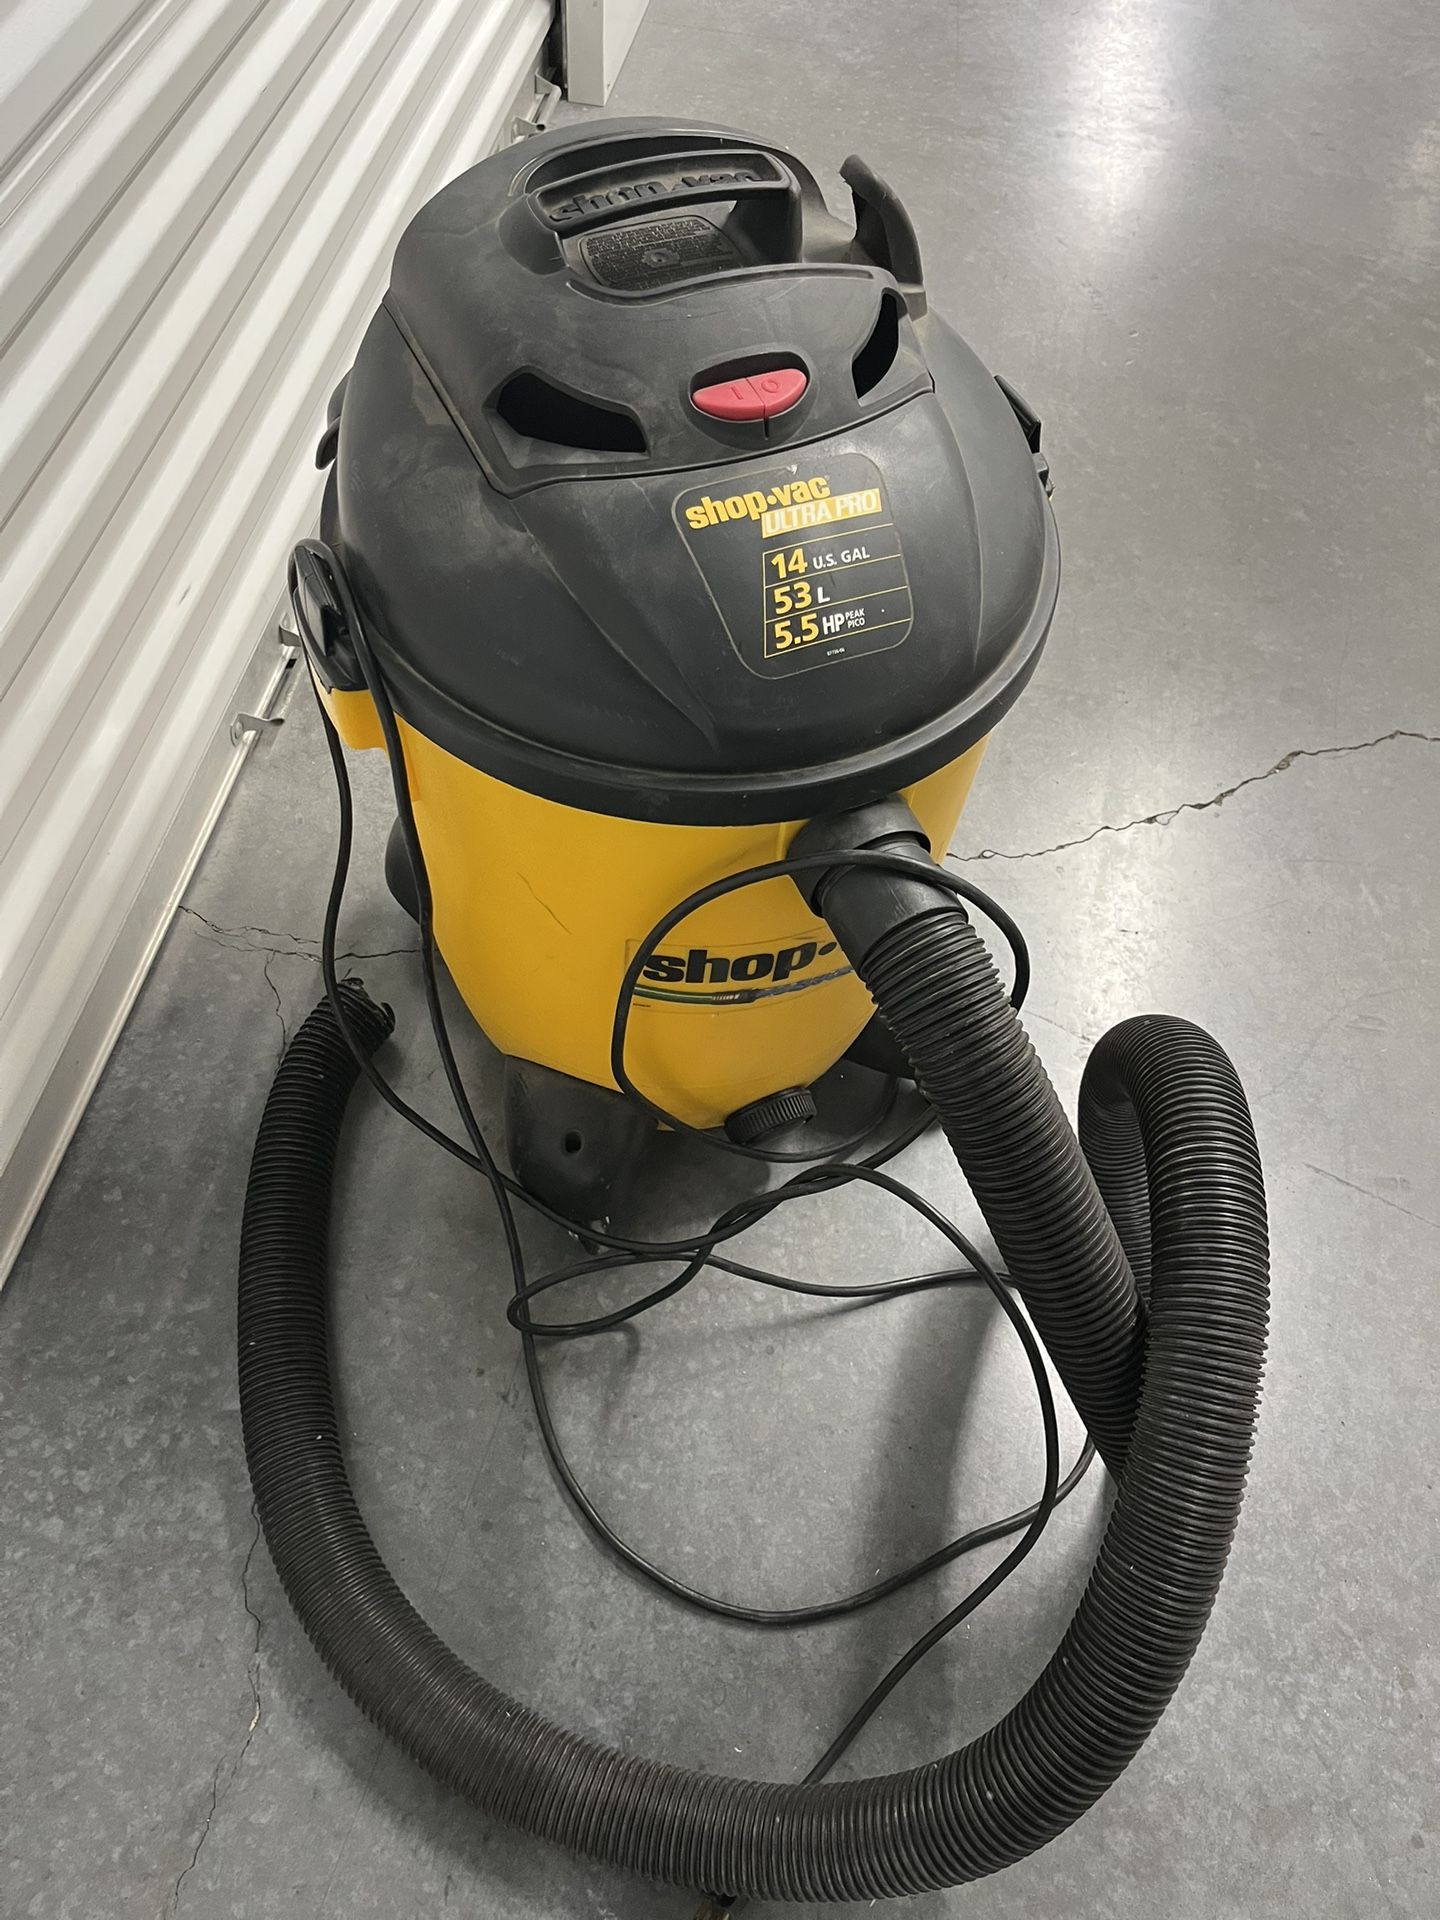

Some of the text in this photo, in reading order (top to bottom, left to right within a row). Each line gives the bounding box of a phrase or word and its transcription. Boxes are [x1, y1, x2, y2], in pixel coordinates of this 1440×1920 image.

[764, 490, 877, 534] ULTRA PRO
[770, 546, 870, 579] 14 U.S. GAL
[773, 581, 830, 615] 53 L
[774, 608, 865, 650] 5.5 HP PEAK
[847, 617, 866, 629] PICO
